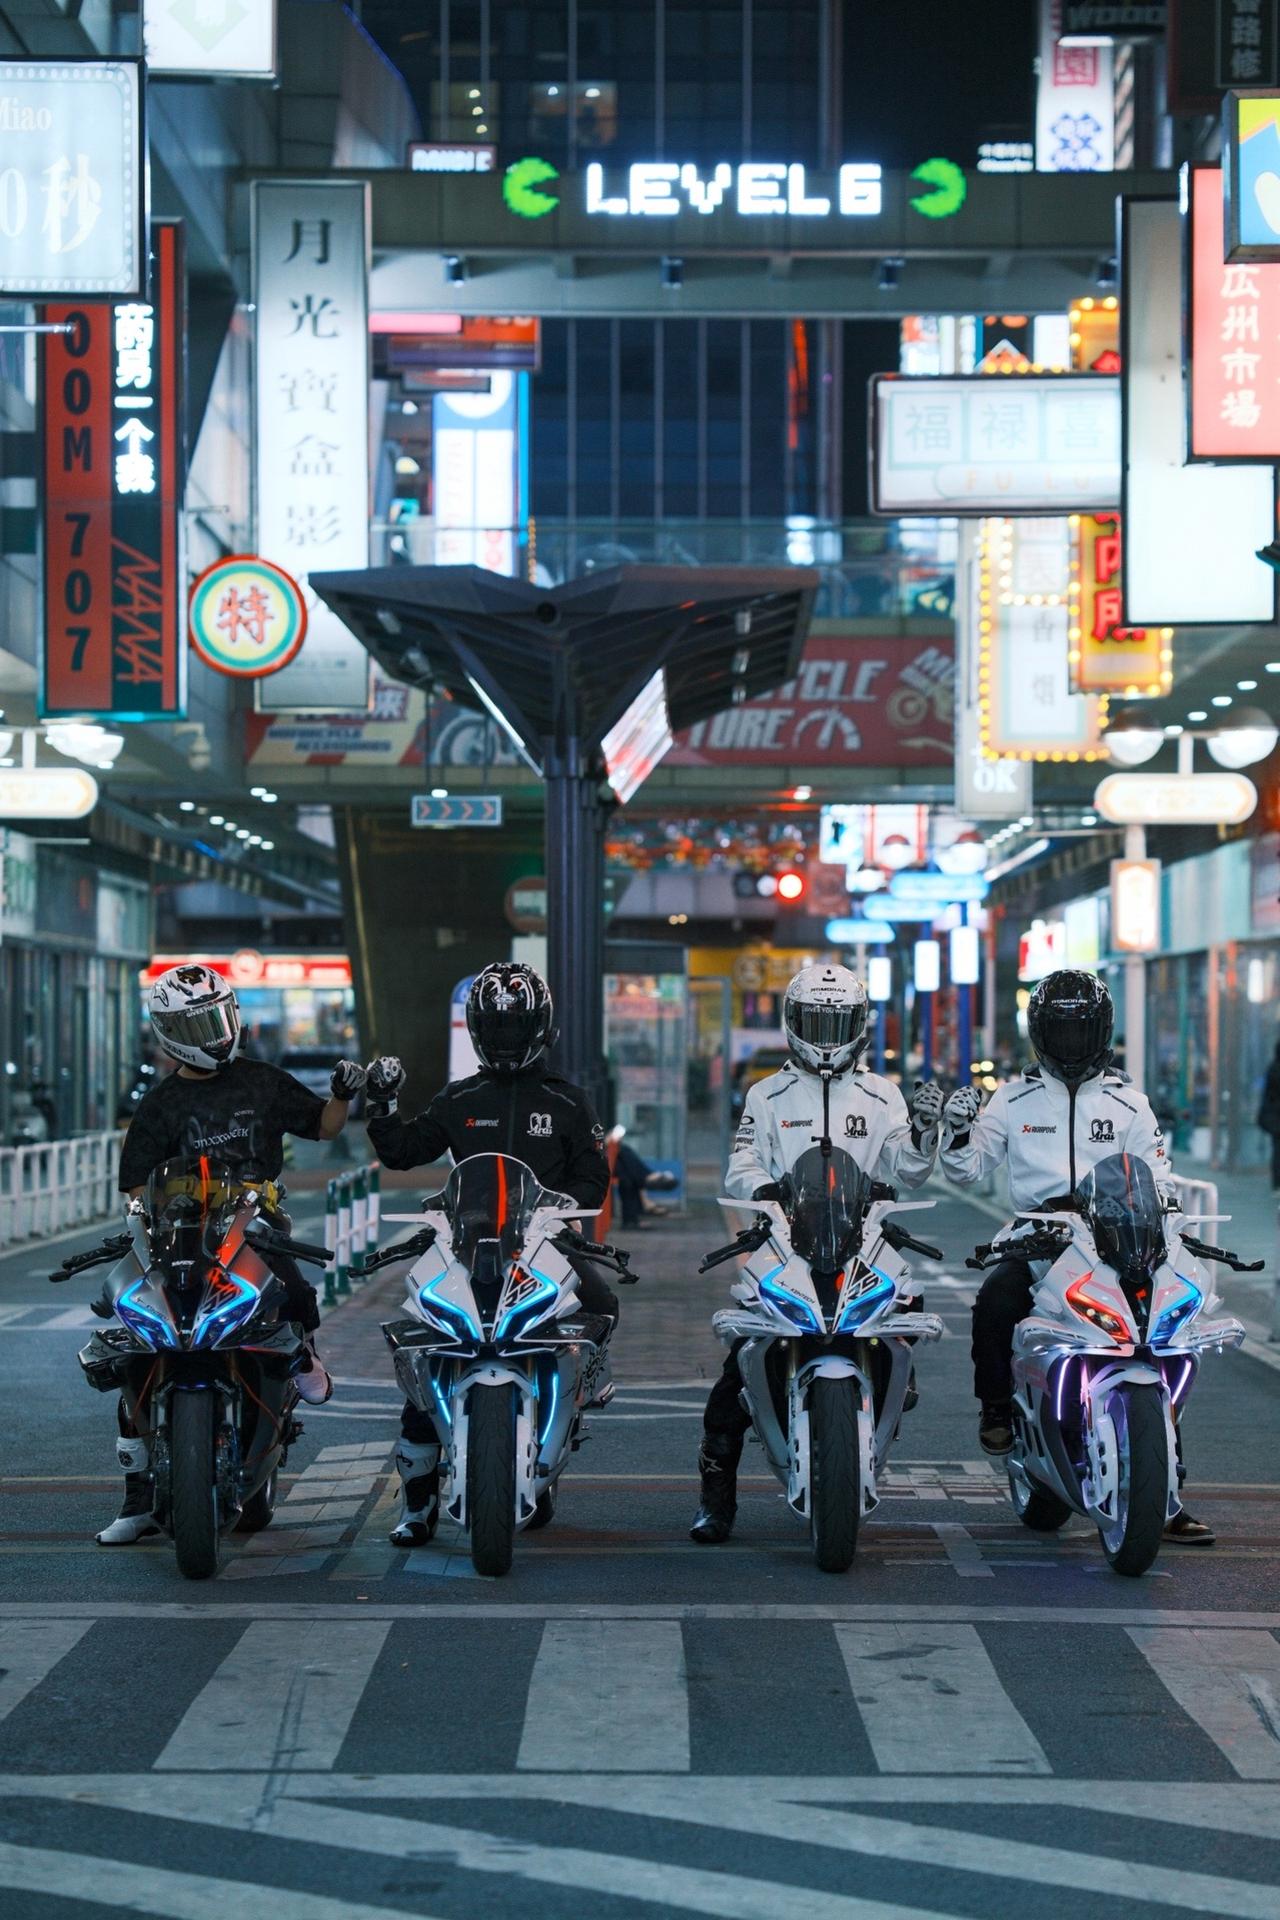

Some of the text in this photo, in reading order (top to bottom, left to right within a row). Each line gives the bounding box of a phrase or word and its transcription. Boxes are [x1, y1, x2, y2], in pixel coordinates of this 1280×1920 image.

[280, 216, 346, 613] 月光寶盒影
[64, 512, 92, 672] 707
[216, 585, 275, 644] 特
[973, 762, 1019, 793] OK
[1088, 1130, 1116, 1141] Arai
